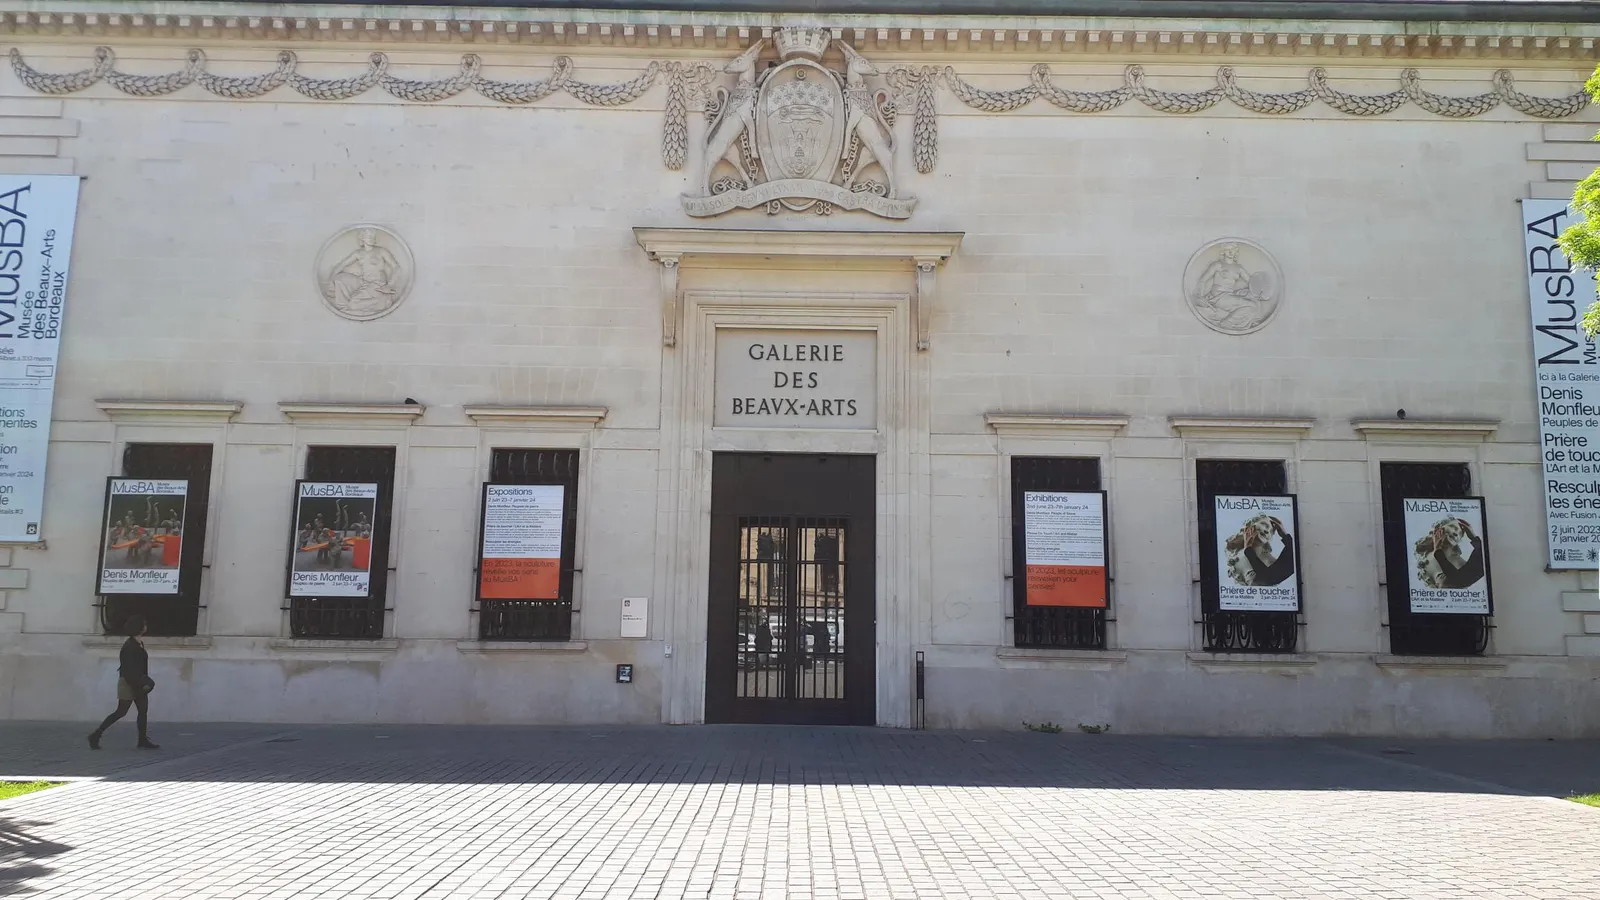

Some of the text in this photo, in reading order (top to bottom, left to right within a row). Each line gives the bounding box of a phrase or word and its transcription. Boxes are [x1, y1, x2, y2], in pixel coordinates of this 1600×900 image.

[765, 201, 832, 214] 19 38
[45, 271, 65, 338] Bordeaux
[18, 290, 34, 338] Musée
[32, 313, 46, 339] des
[749, 344, 844, 362] GALERIE
[774, 372, 818, 388] DES
[1551, 373, 1556, 381] à
[1559, 373, 1566, 381] la
[1568, 373, 1599, 381] Galerie
[1541, 386, 1583, 400] Denis
[732, 398, 857, 416] BEAVX-ARTS
[1542, 417, 1598, 428] Peuples de
[1544, 433, 1587, 446] Prière
[1545, 448, 1565, 461] de
[1546, 464, 1566, 473] L'Art
[1569, 464, 1579, 473] et
[1582, 464, 1590, 473] la
[113, 482, 155, 494] MusBA
[302, 485, 344, 496] MusBA
[488, 488, 533, 496] Expositions
[1026, 494, 1068, 503] Exhibitions
[1217, 498, 1260, 510] MusBA
[1549, 495, 1570, 508] les
[1406, 501, 1449, 512] MusBA
[1551, 525, 1557, 534] 2
[1560, 525, 1575, 535] juin
[1560, 534, 1588, 544] janvier
[103, 570, 168, 579] Denis Monfleur
[294, 573, 359, 581] Denis Monfleur
[1220, 586, 1244, 595] Prière
[1411, 589, 1435, 597] Prière
